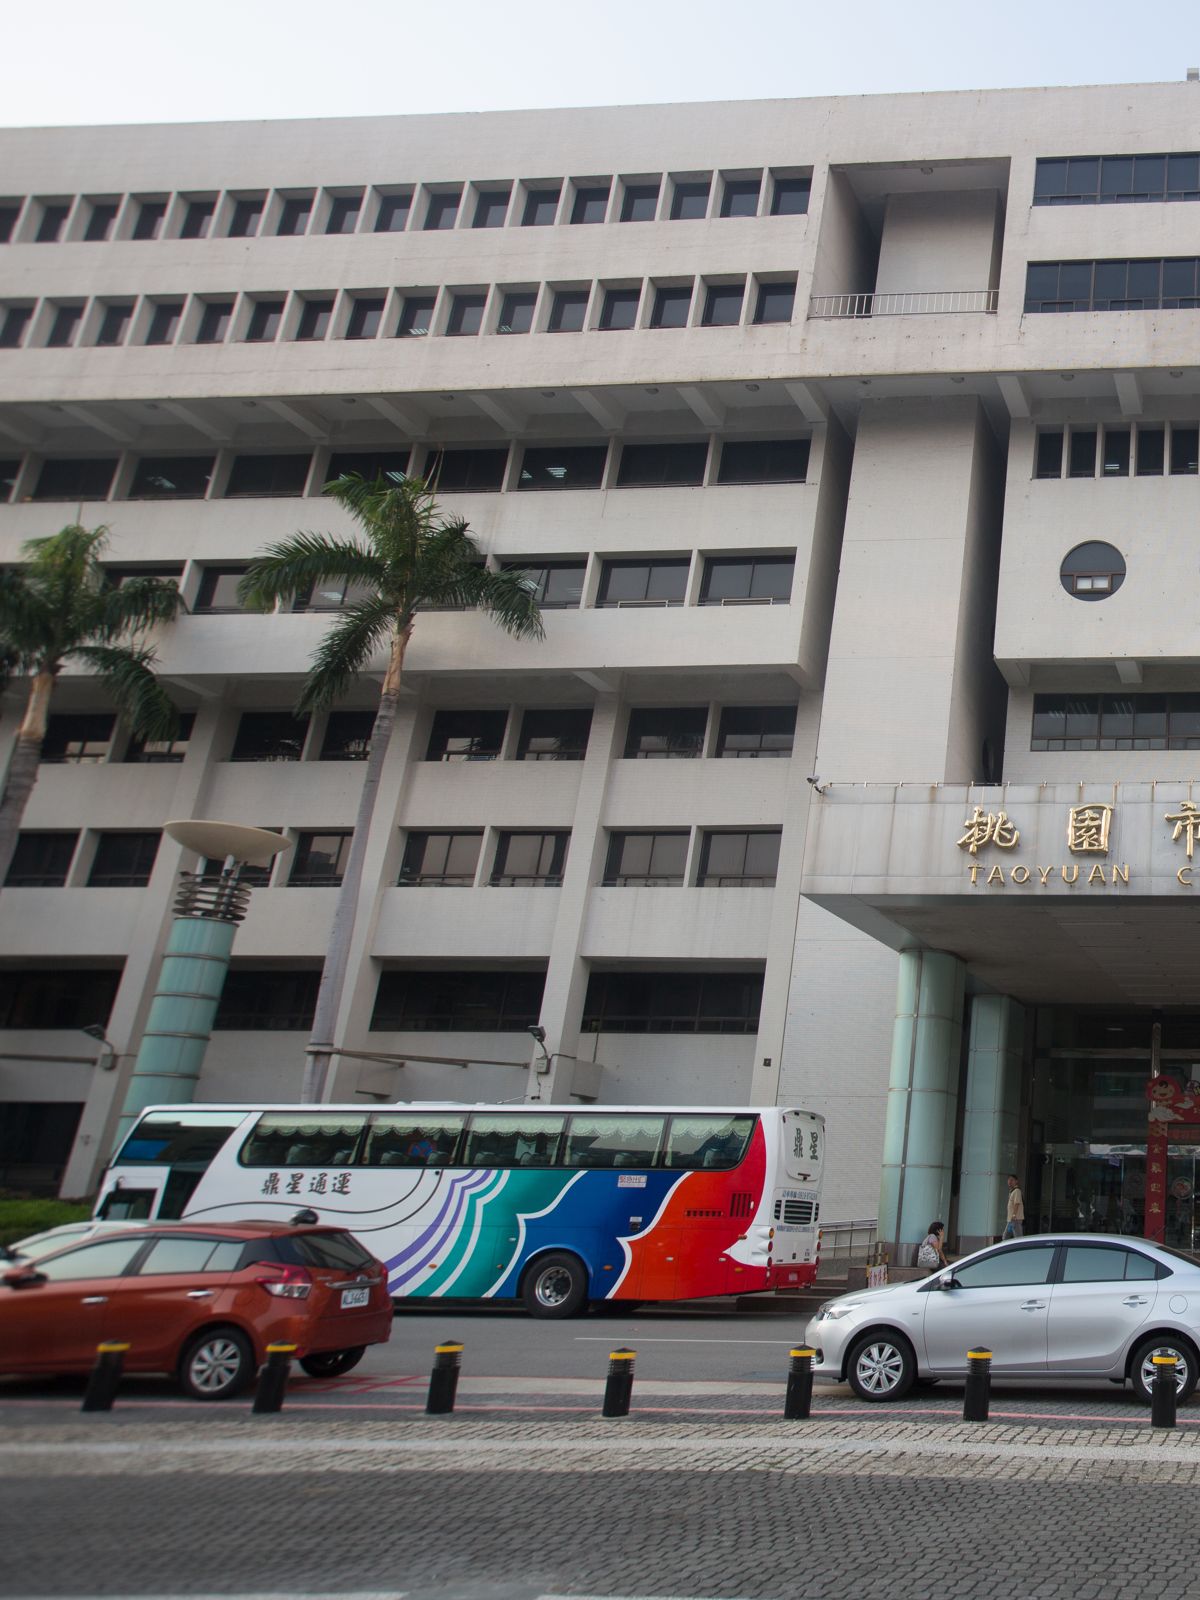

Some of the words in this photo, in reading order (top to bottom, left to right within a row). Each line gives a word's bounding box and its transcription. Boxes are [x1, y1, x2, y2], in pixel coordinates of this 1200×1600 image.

[967, 864, 1131, 886] TAOYUAN
[261, 1172, 352, 1196] 鼎星通運
